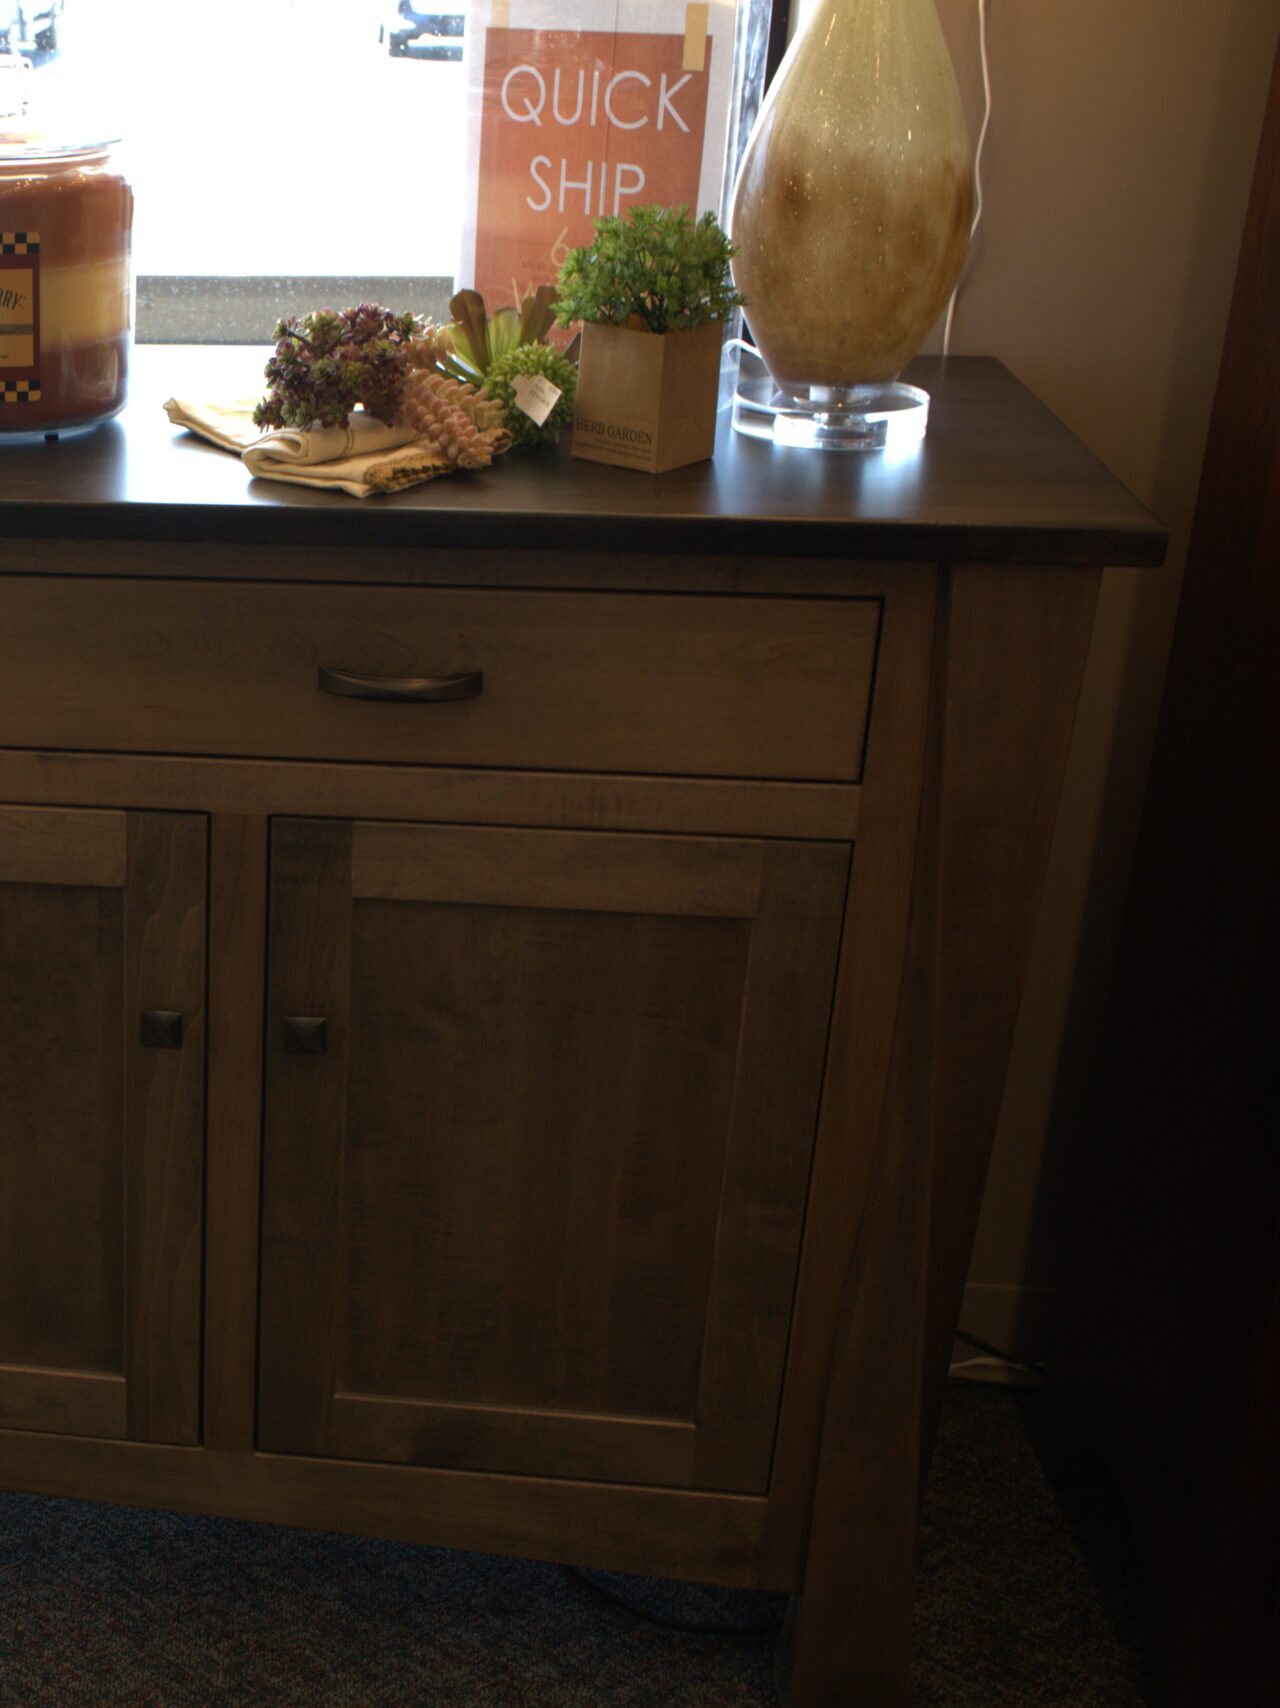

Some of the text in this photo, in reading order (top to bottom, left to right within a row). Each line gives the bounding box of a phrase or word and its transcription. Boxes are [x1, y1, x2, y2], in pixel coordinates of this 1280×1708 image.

[500, 64, 693, 134] QUICK
[526, 155, 645, 218] SHIP
[575, 416, 605, 435] HERB
[607, 424, 653, 446] GARDEN
